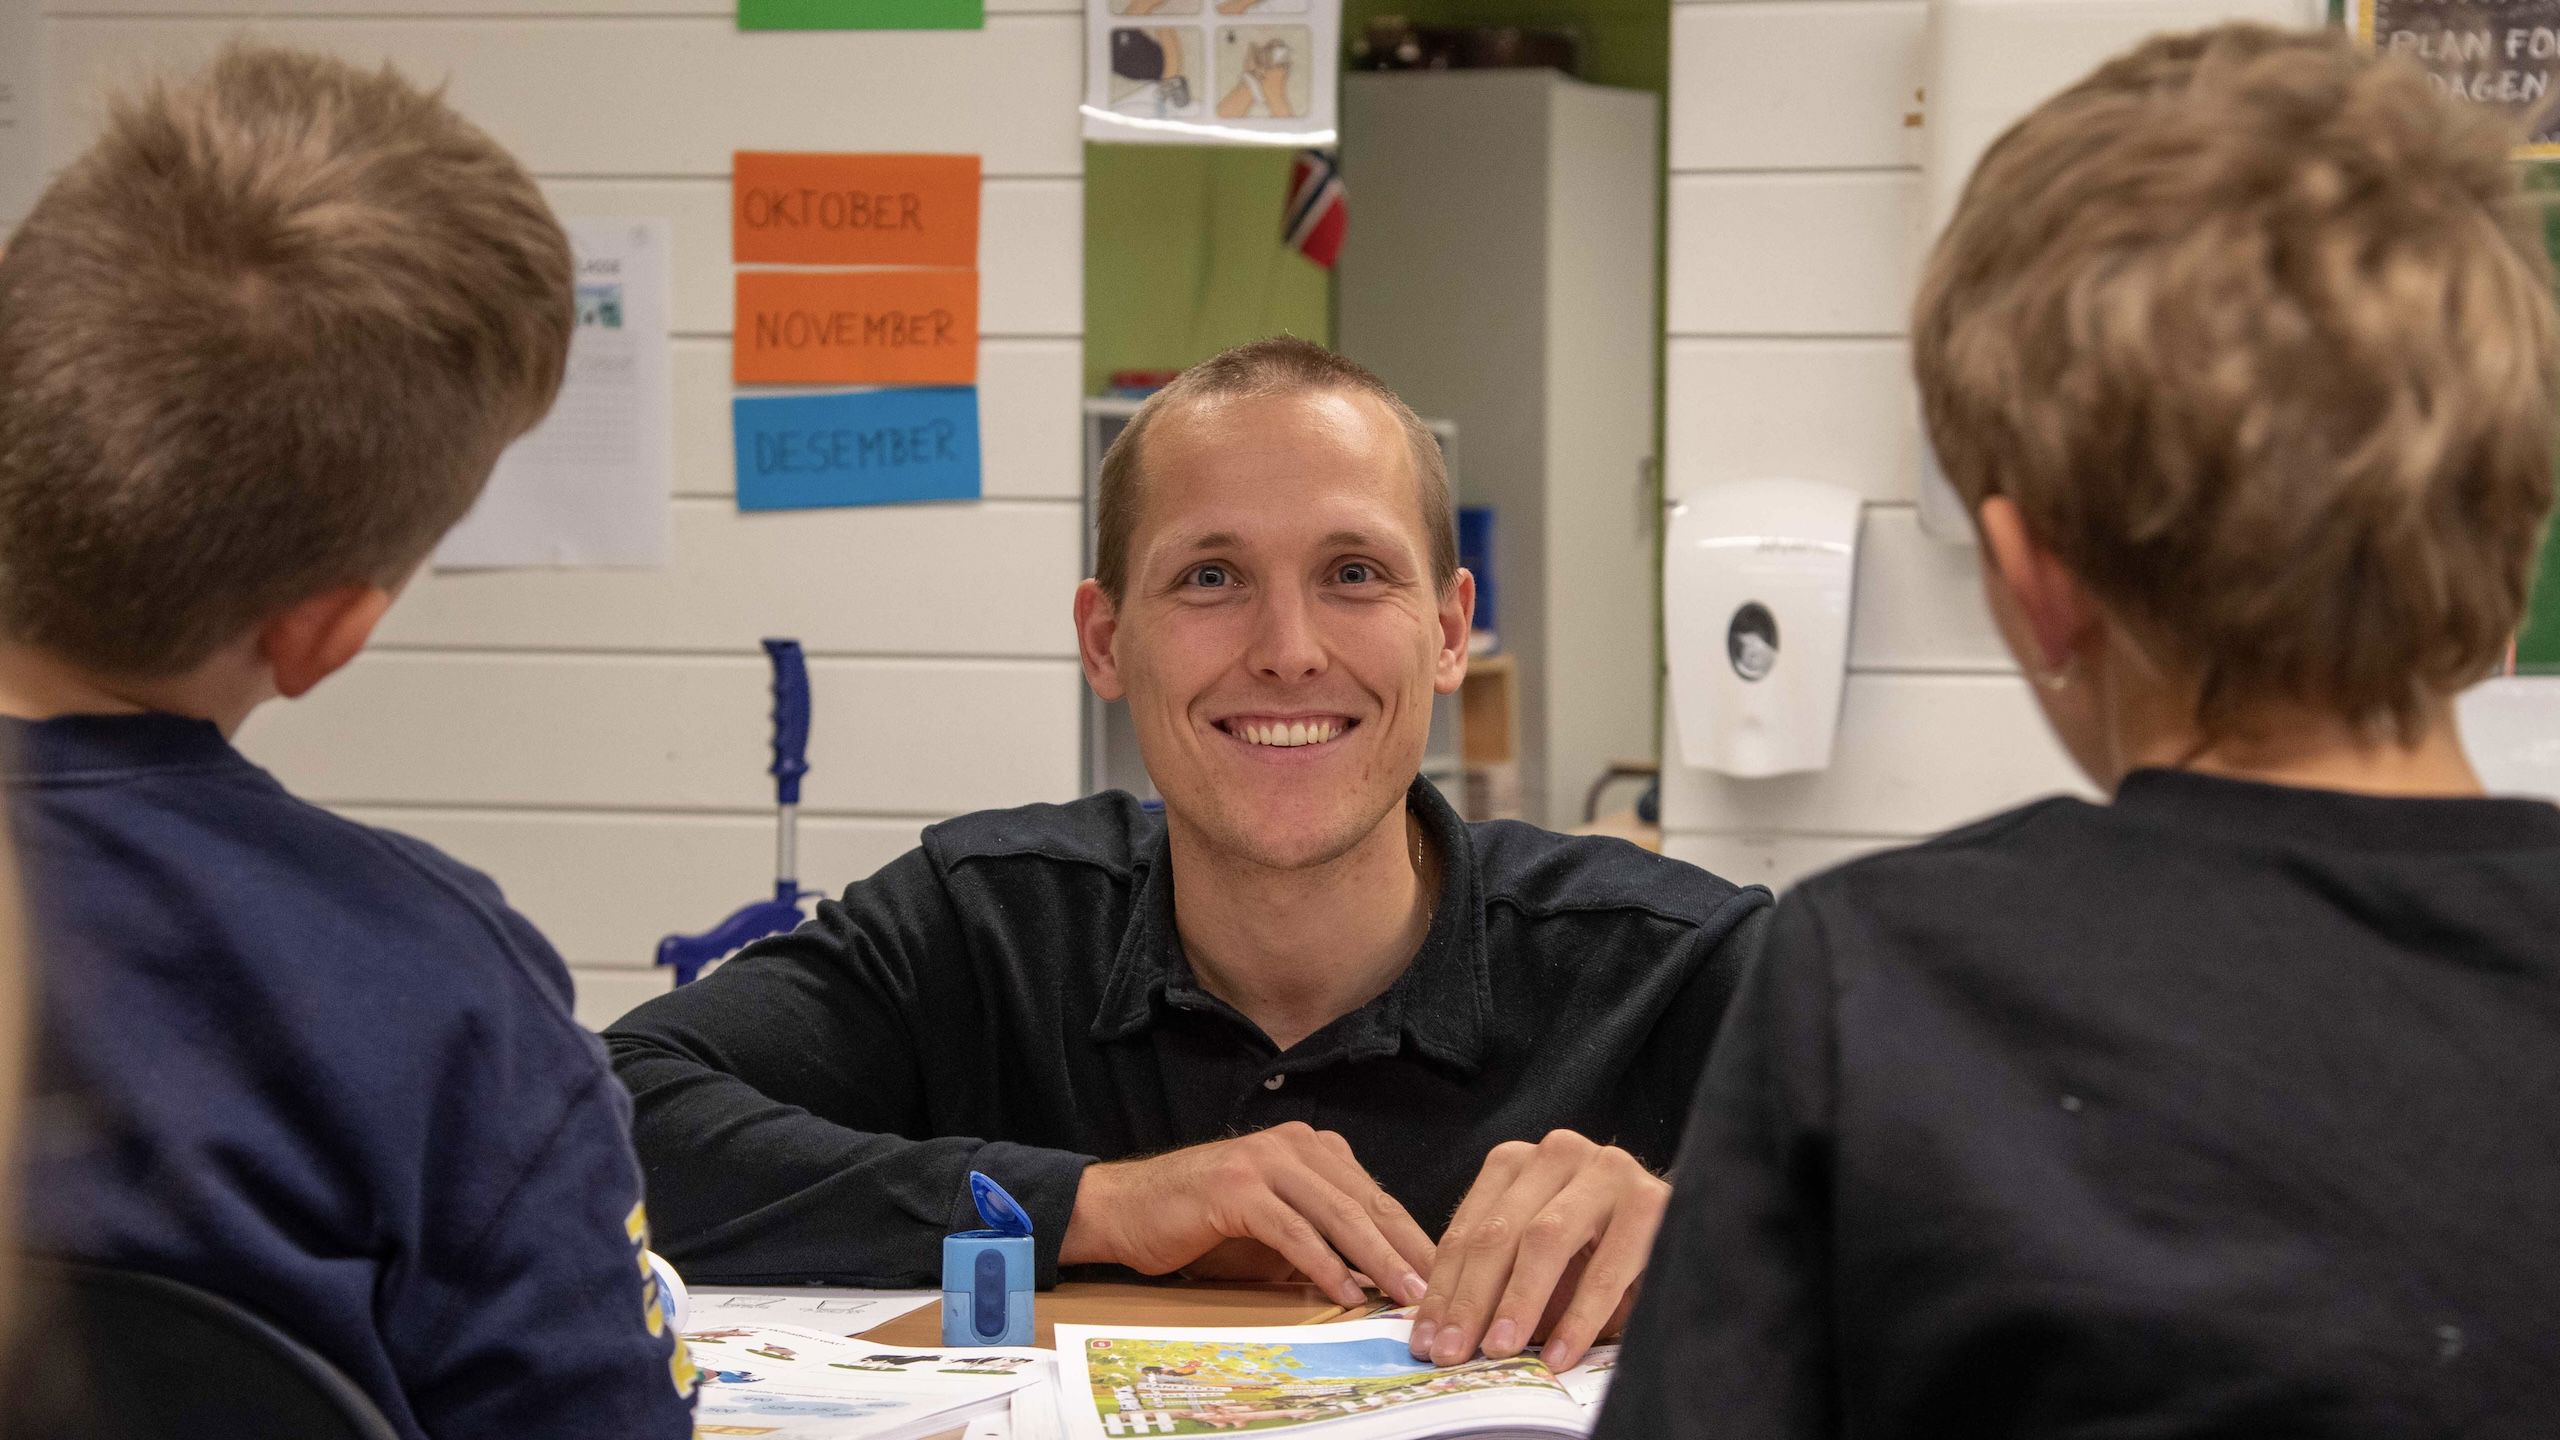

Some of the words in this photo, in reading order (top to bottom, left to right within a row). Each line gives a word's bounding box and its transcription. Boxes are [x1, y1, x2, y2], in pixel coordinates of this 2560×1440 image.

[2388, 28, 2493, 62] PLAN
[742, 187, 924, 232] OKTOBER
[754, 308, 957, 350] NOVEMBER
[754, 417, 959, 476] DESEMBER
